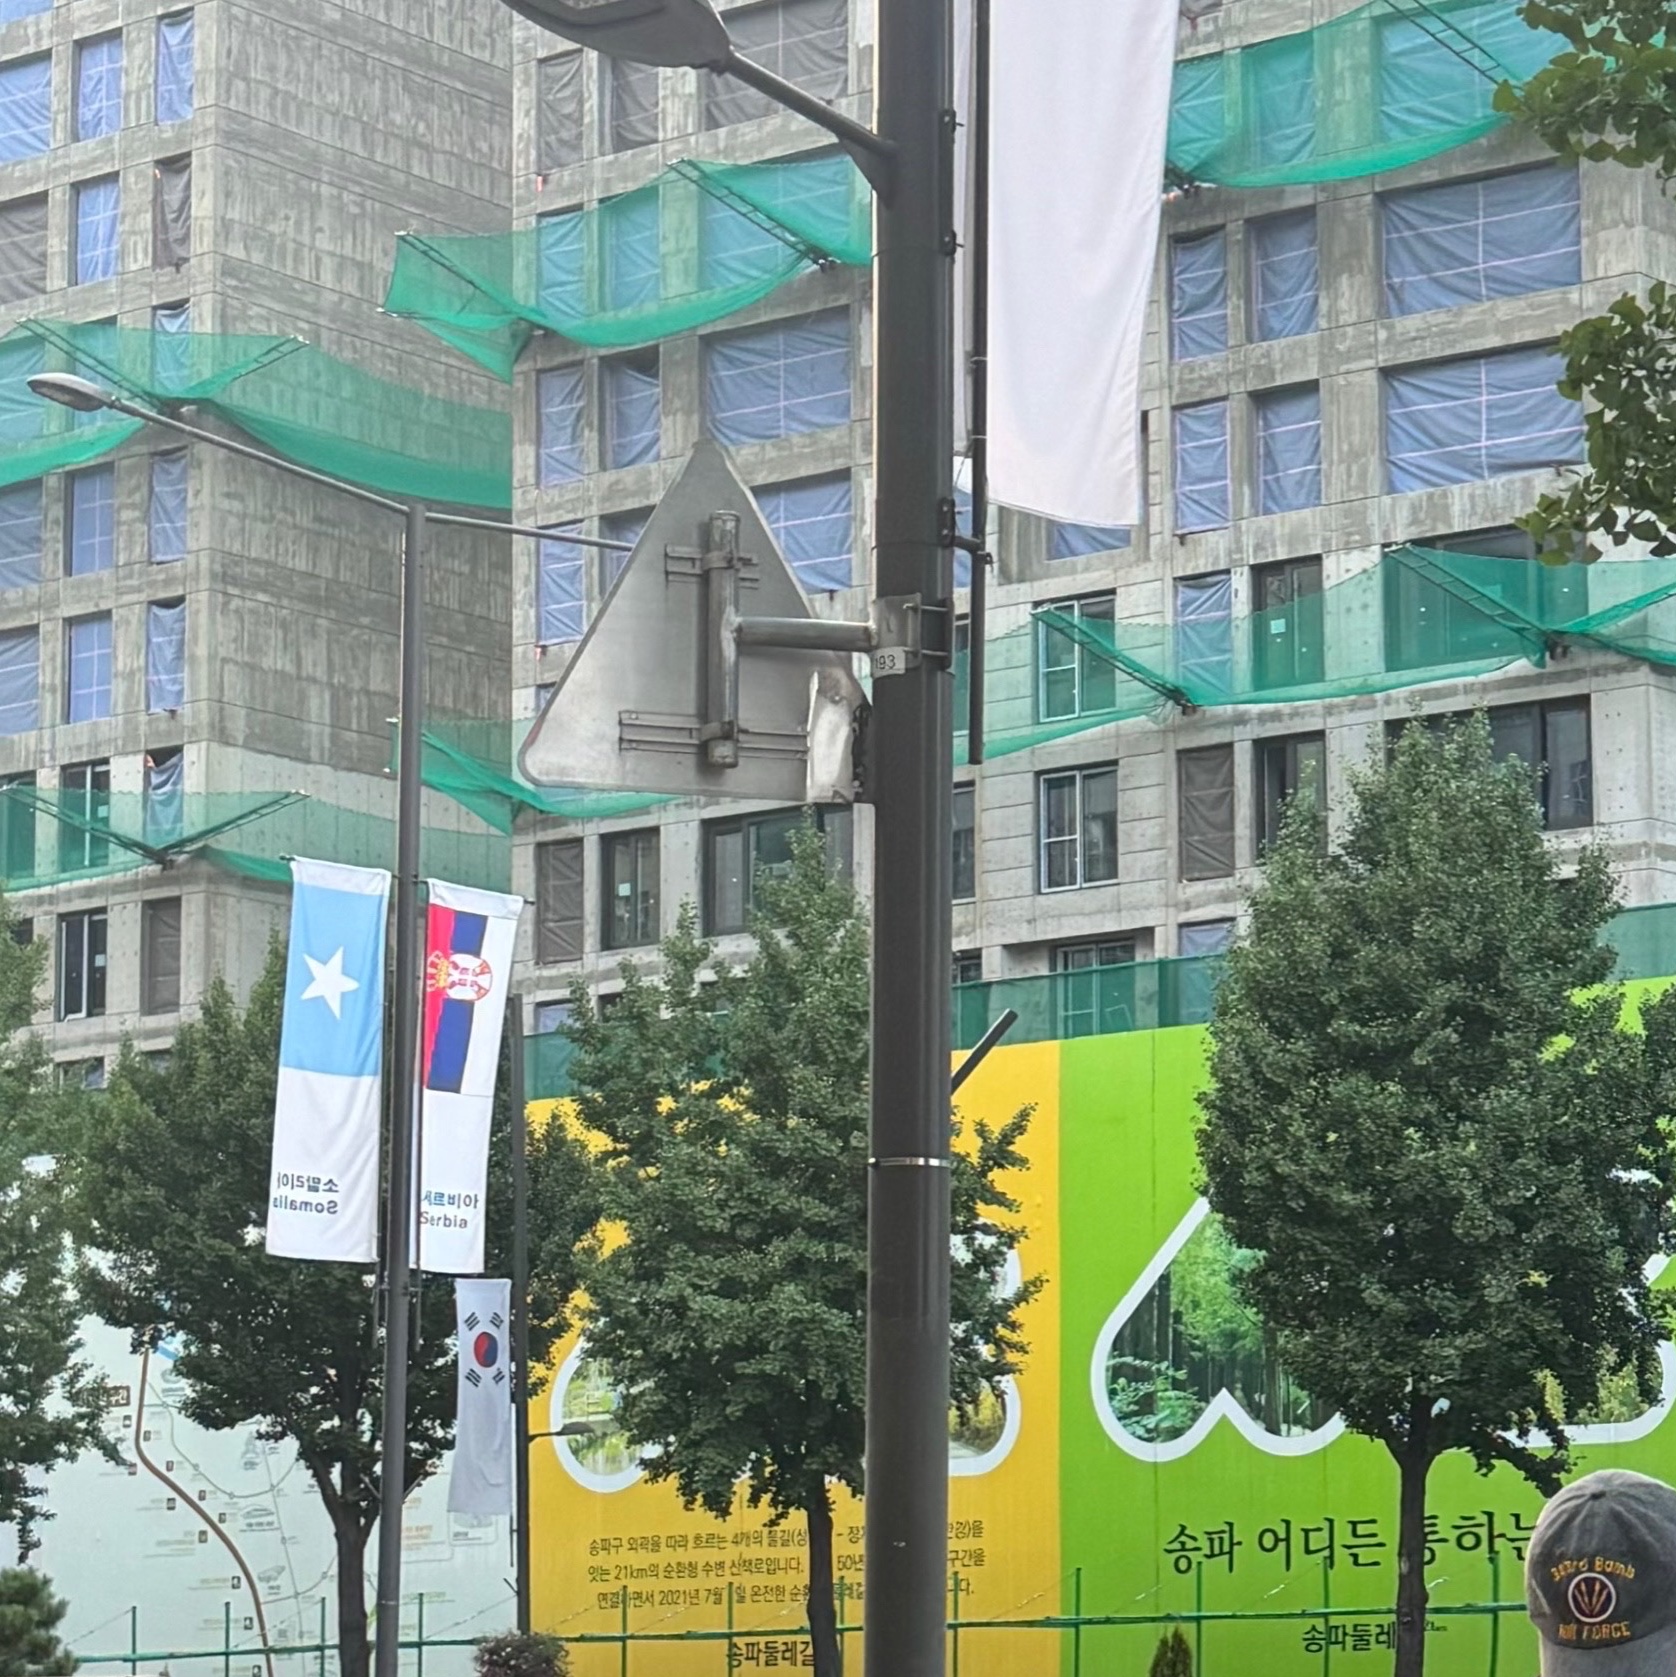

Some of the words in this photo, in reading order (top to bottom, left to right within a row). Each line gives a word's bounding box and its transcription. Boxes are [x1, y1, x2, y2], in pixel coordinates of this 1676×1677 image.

[419, 1211, 468, 1229] Serbia
[589, 1537, 624, 1557] 송파구
[665, 1534, 689, 1552] 따라
[692, 1532, 728, 1550] 흐르는
[1162, 1520, 1243, 1575] 송파
[1257, 1516, 1388, 1572] 어디든
[587, 1565, 611, 1583] 잇는
[613, 1563, 660, 1580] 21km의
[663, 1560, 699, 1579] 순환형
[701, 1560, 726, 1578] 수변
[658, 1589, 701, 1606] 2021년
[750, 1584, 786, 1603] 온전한
[1302, 1620, 1397, 1653] 송파둘레
[1582, 1620, 1632, 1640] FORCE
